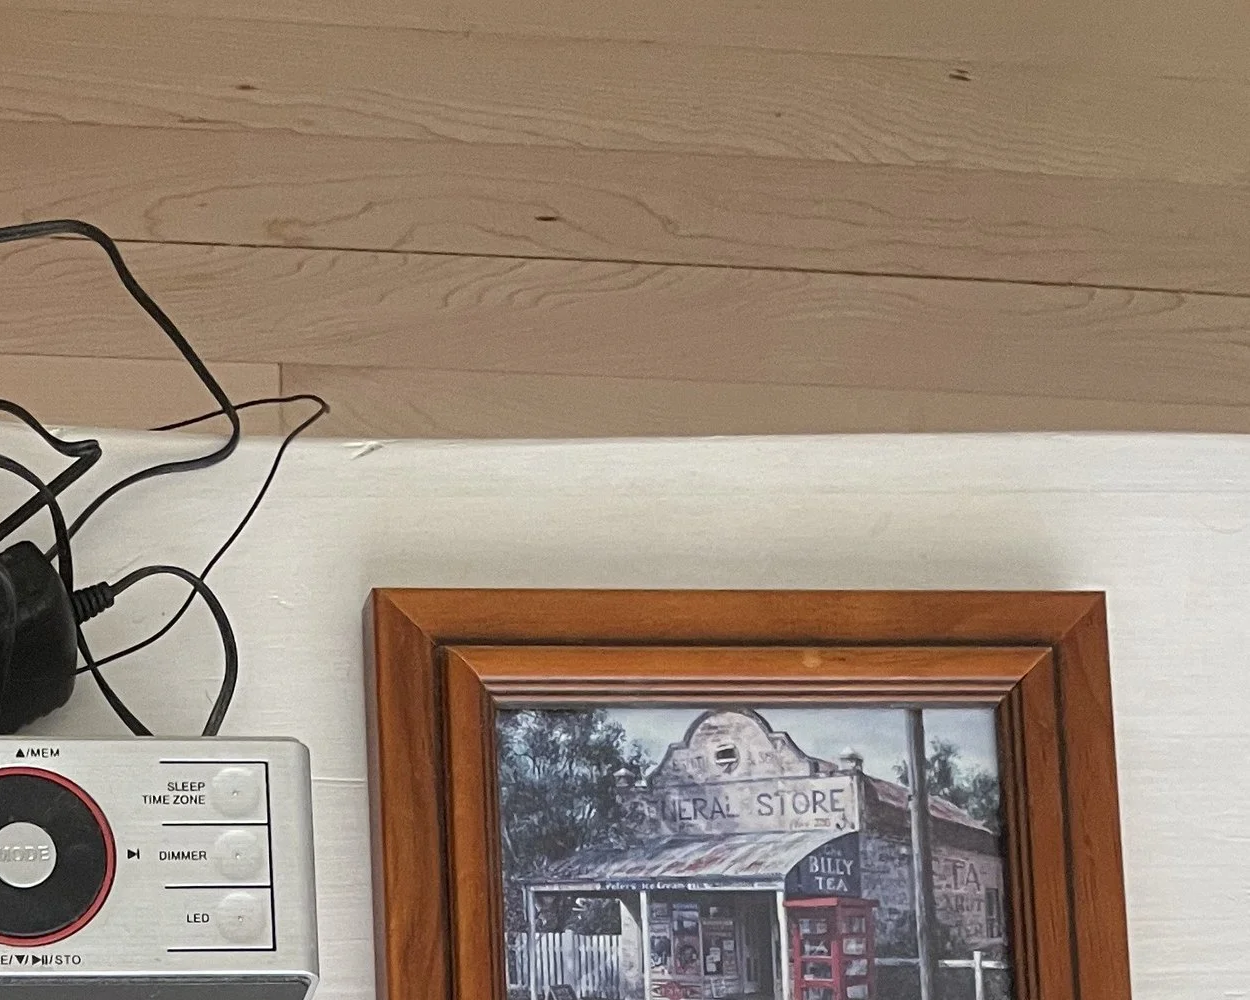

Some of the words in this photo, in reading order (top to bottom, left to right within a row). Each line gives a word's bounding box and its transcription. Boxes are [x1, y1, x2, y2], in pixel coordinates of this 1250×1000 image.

[167, 782, 205, 792] SLEEP
[142, 795, 170, 805] TIME
[173, 795, 206, 805] ZONE
[756, 788, 845, 816] STORE
[159, 851, 207, 861] DIMMER
[809, 855, 854, 876] BILLY
[814, 876, 848, 892] TEA
[186, 913, 210, 924] LED
